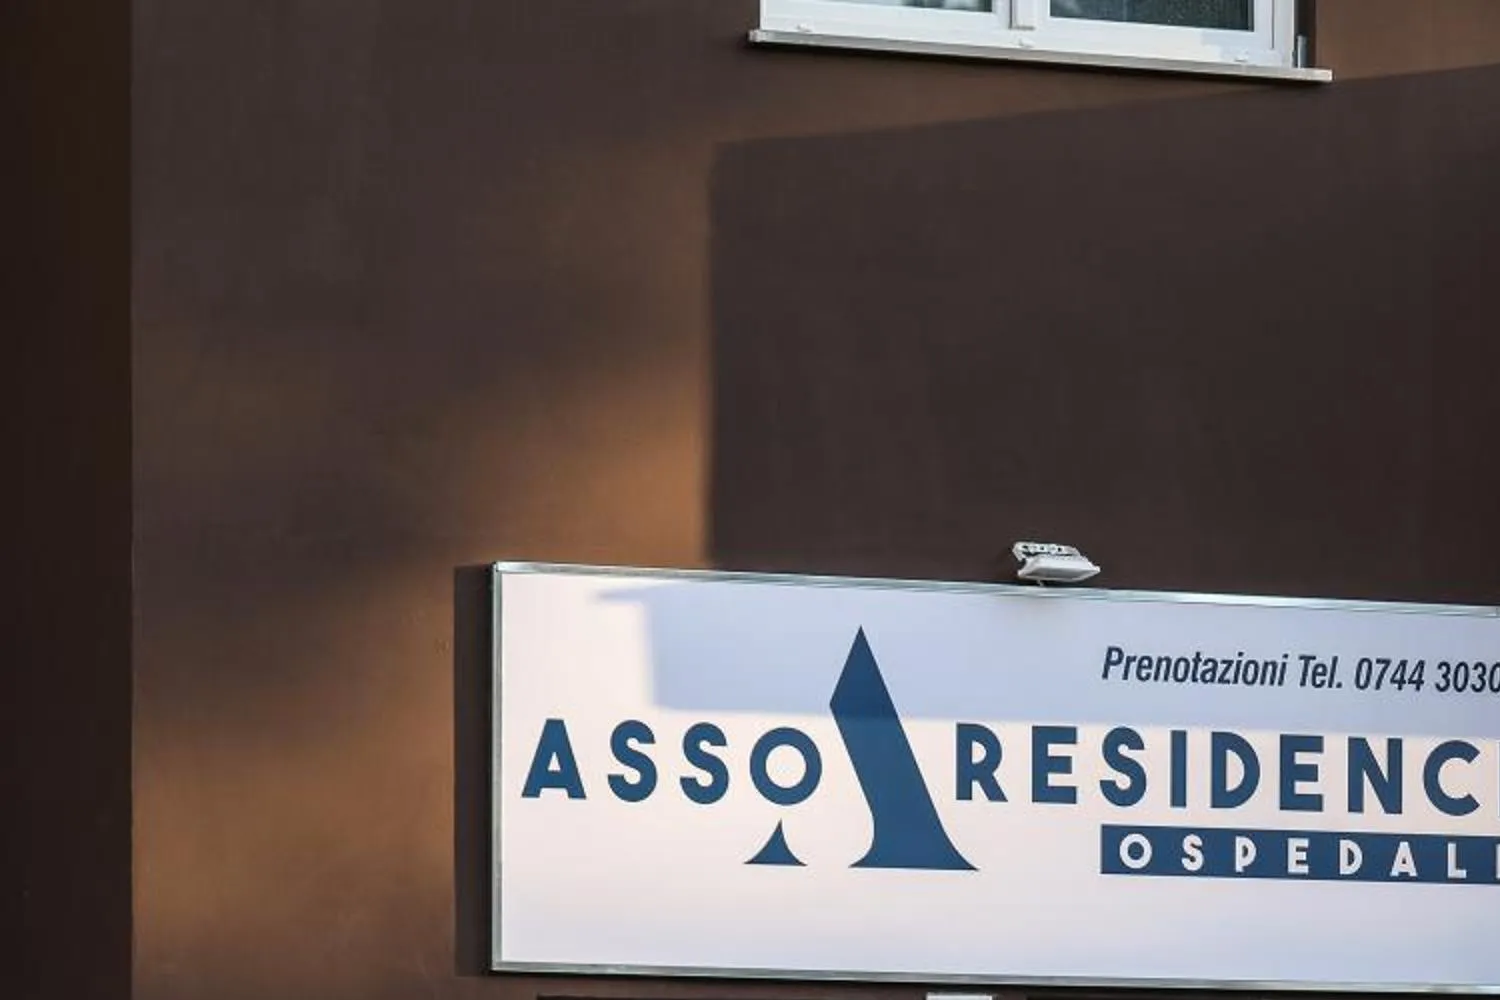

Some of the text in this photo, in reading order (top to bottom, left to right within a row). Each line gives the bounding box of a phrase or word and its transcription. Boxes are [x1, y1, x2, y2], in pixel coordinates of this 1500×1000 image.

[1101, 646, 1290, 688] Prenotazioni
[1298, 654, 1344, 690] Tel.
[1354, 657, 1426, 692] 0744
[522, 718, 823, 806] ASSO
